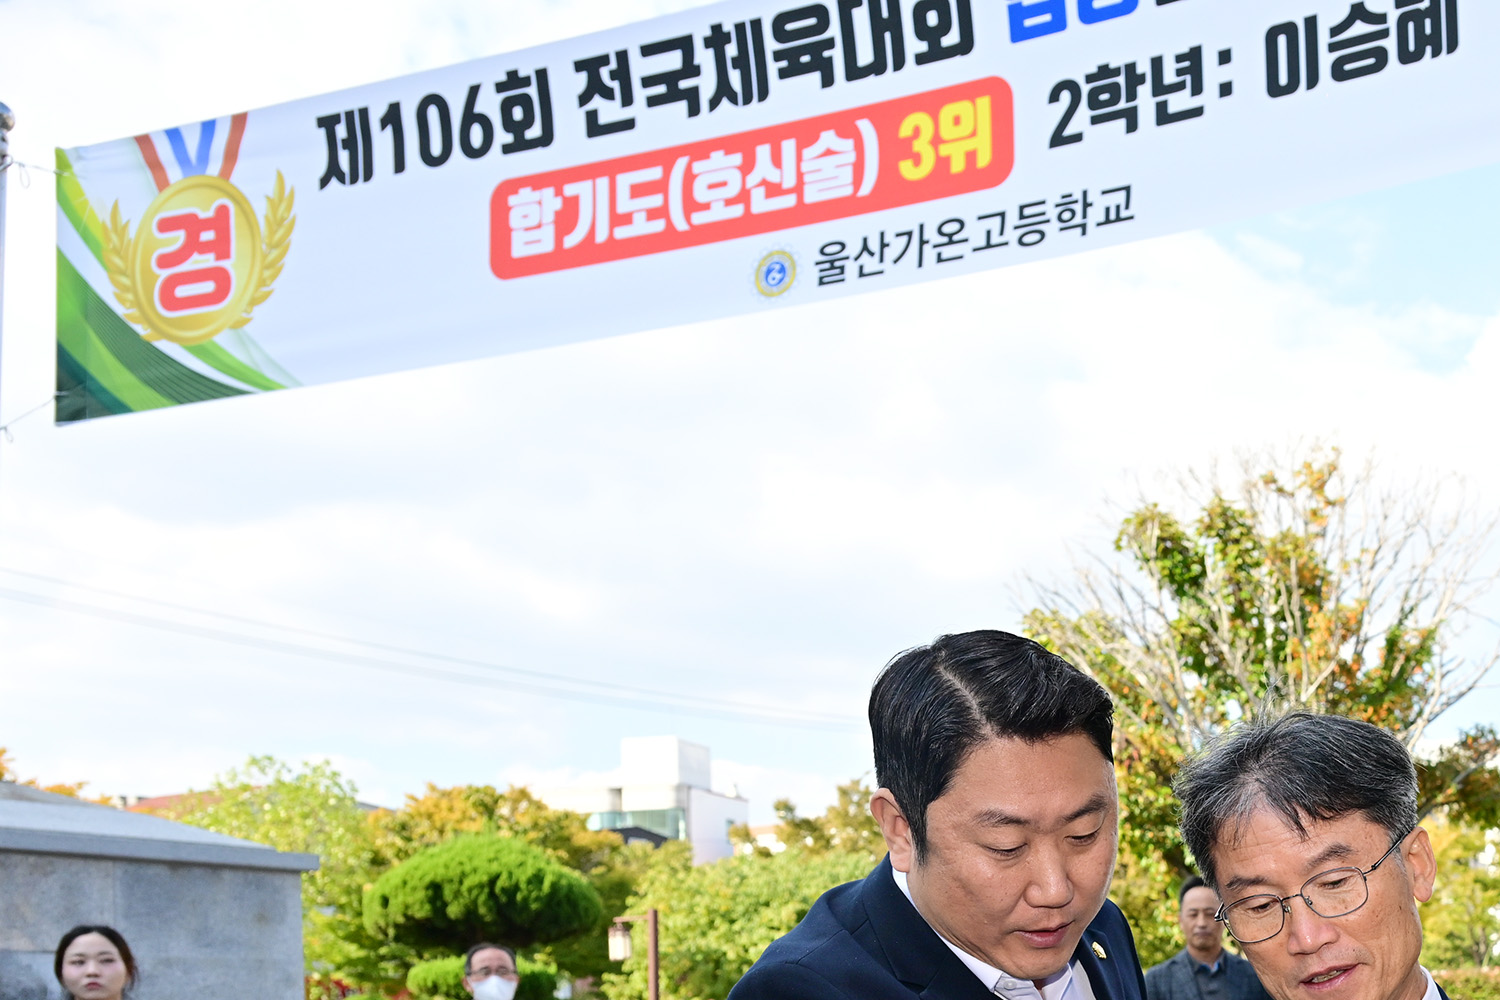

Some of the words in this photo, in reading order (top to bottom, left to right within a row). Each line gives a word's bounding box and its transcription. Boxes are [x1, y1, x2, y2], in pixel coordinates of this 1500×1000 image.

[316, 66, 556, 191] 제106회
[573, 0, 976, 139] 전국체육대회
[1048, 44, 1235, 149] 2학년:
[507, 117, 881, 259] 합기도(호신술)
[897, 94, 993, 182] 3위
[154, 203, 235, 314] 경
[814, 184, 1136, 287] 울산가온고등학교
